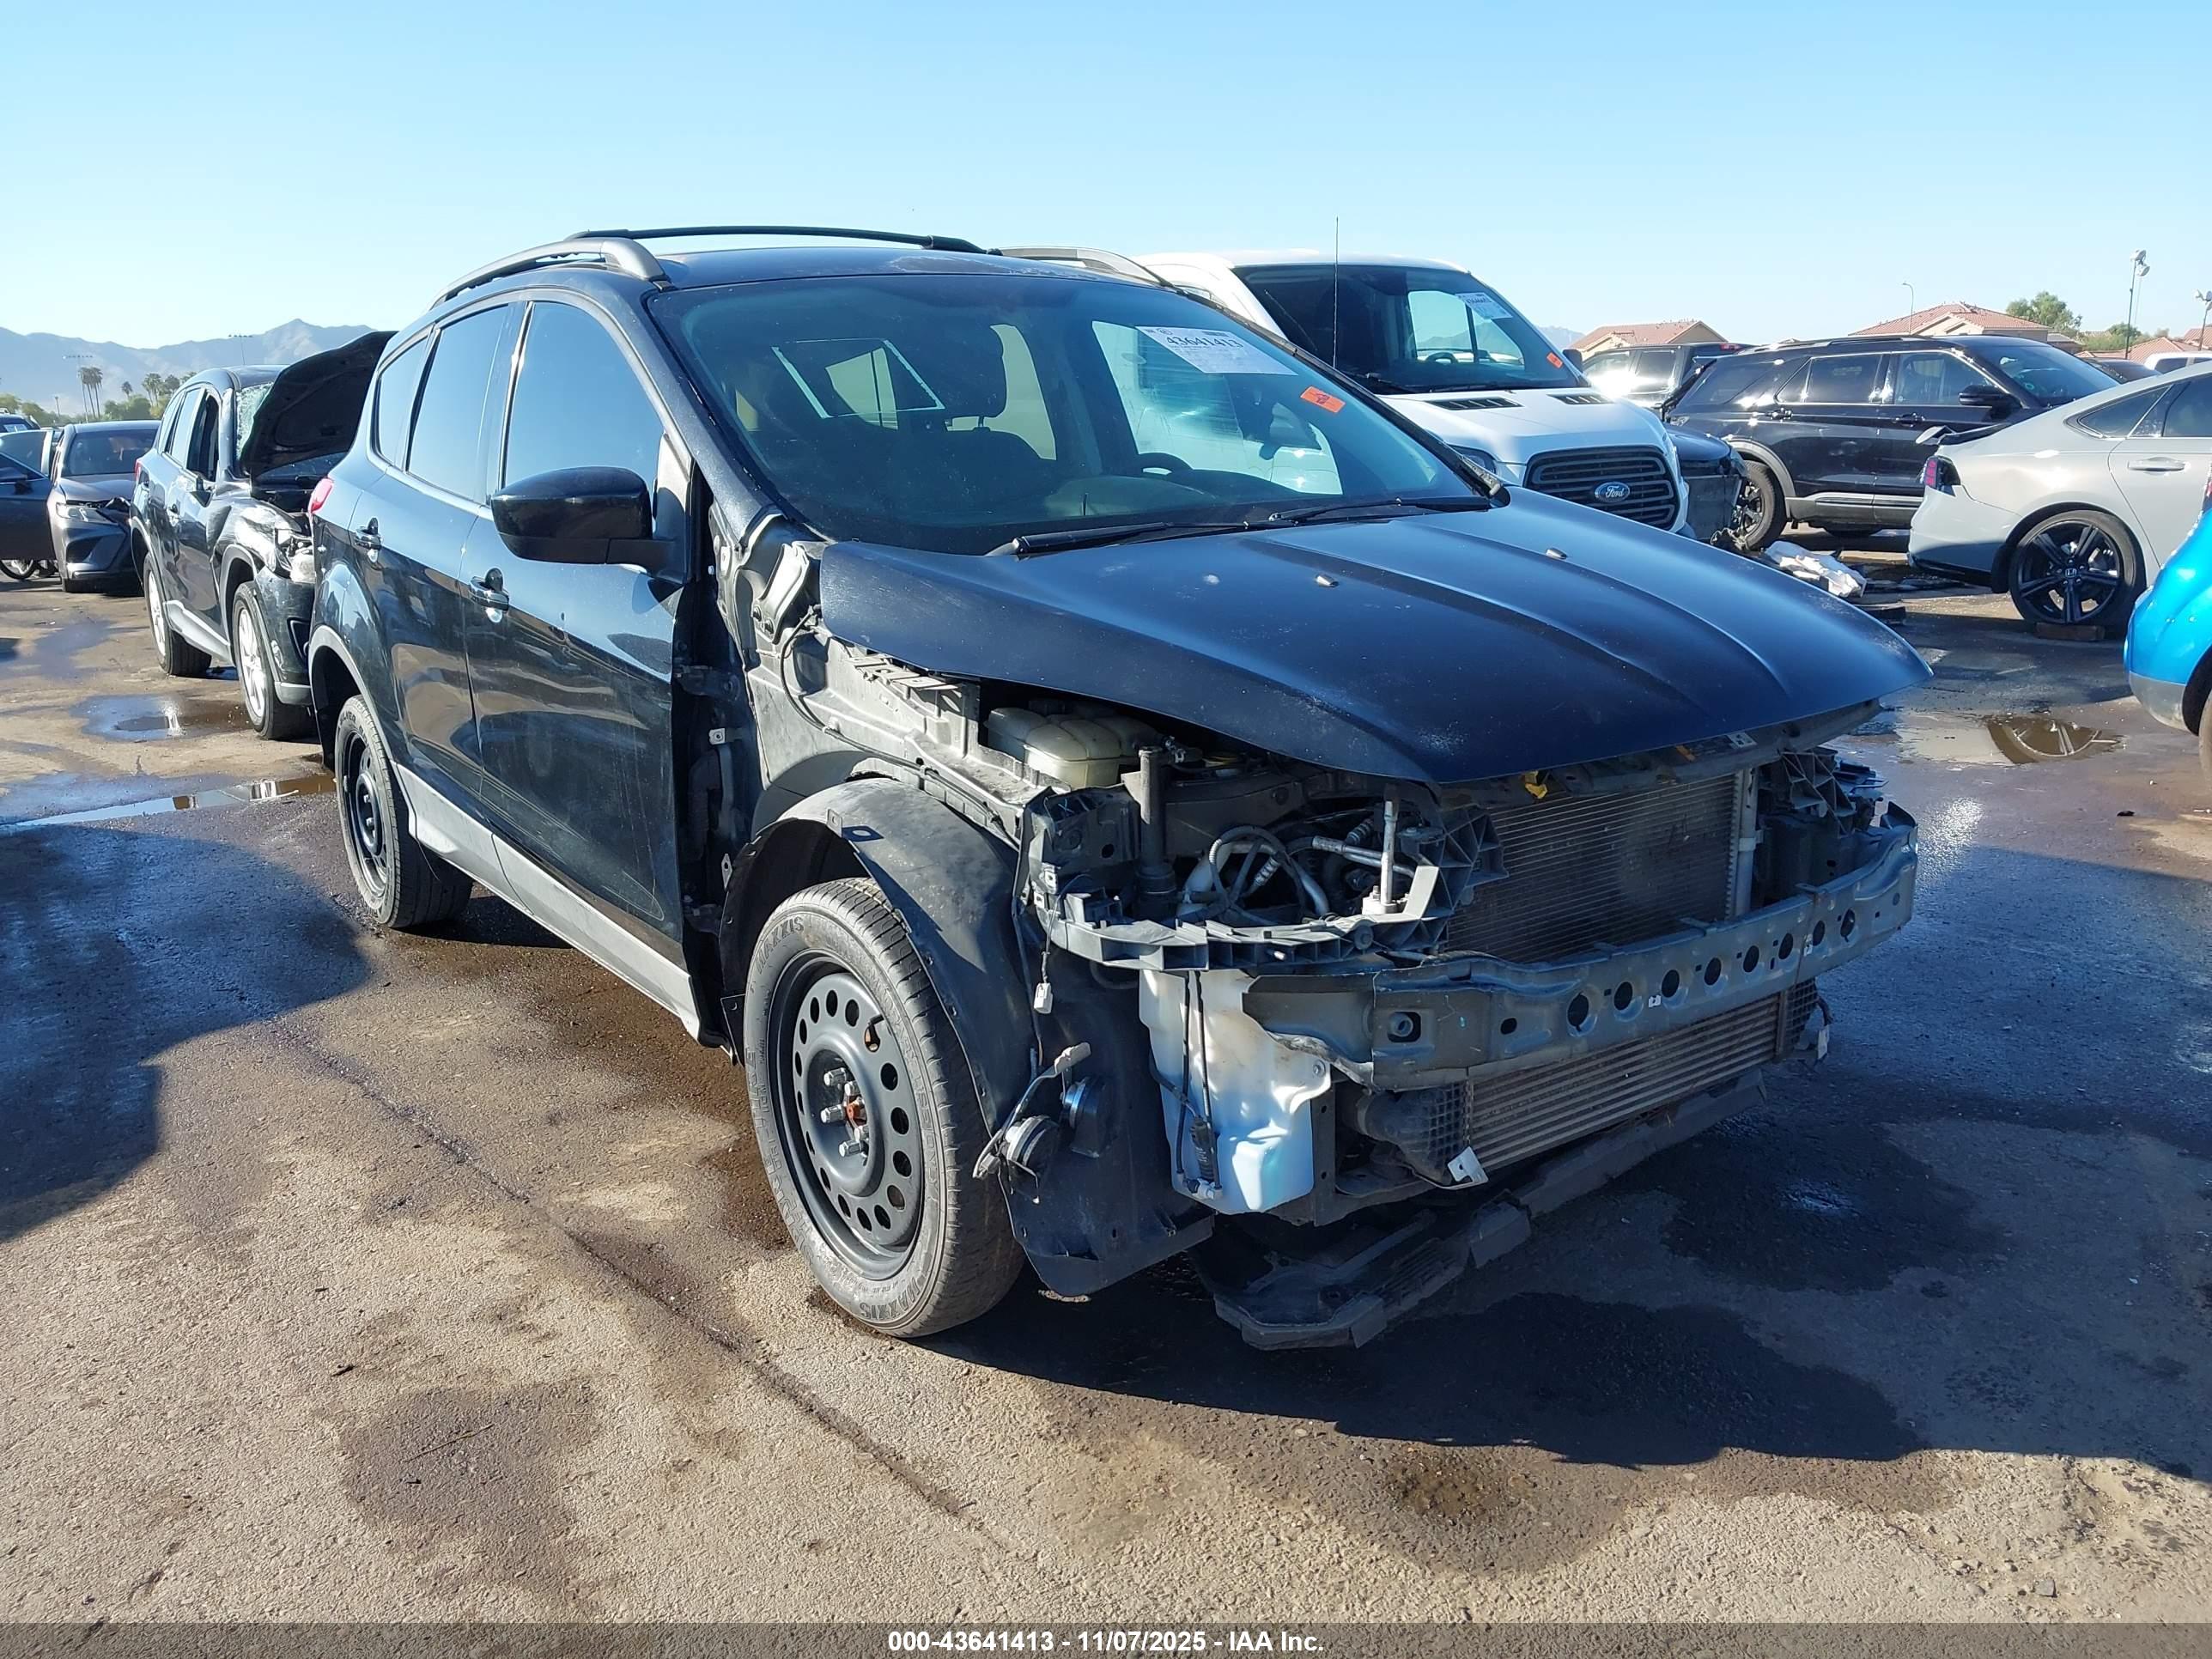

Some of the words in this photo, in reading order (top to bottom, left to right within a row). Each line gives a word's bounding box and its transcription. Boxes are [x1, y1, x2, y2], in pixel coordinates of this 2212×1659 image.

[1166, 337, 1244, 349] 43641413
[1605, 485, 1625, 499] Ford
[756, 916, 805, 975] MAXXIS
[744, 1045, 766, 1130] TIRE
[763, 1153, 814, 1270] SPARE
[859, 1277, 921, 1320] MAXXIS
